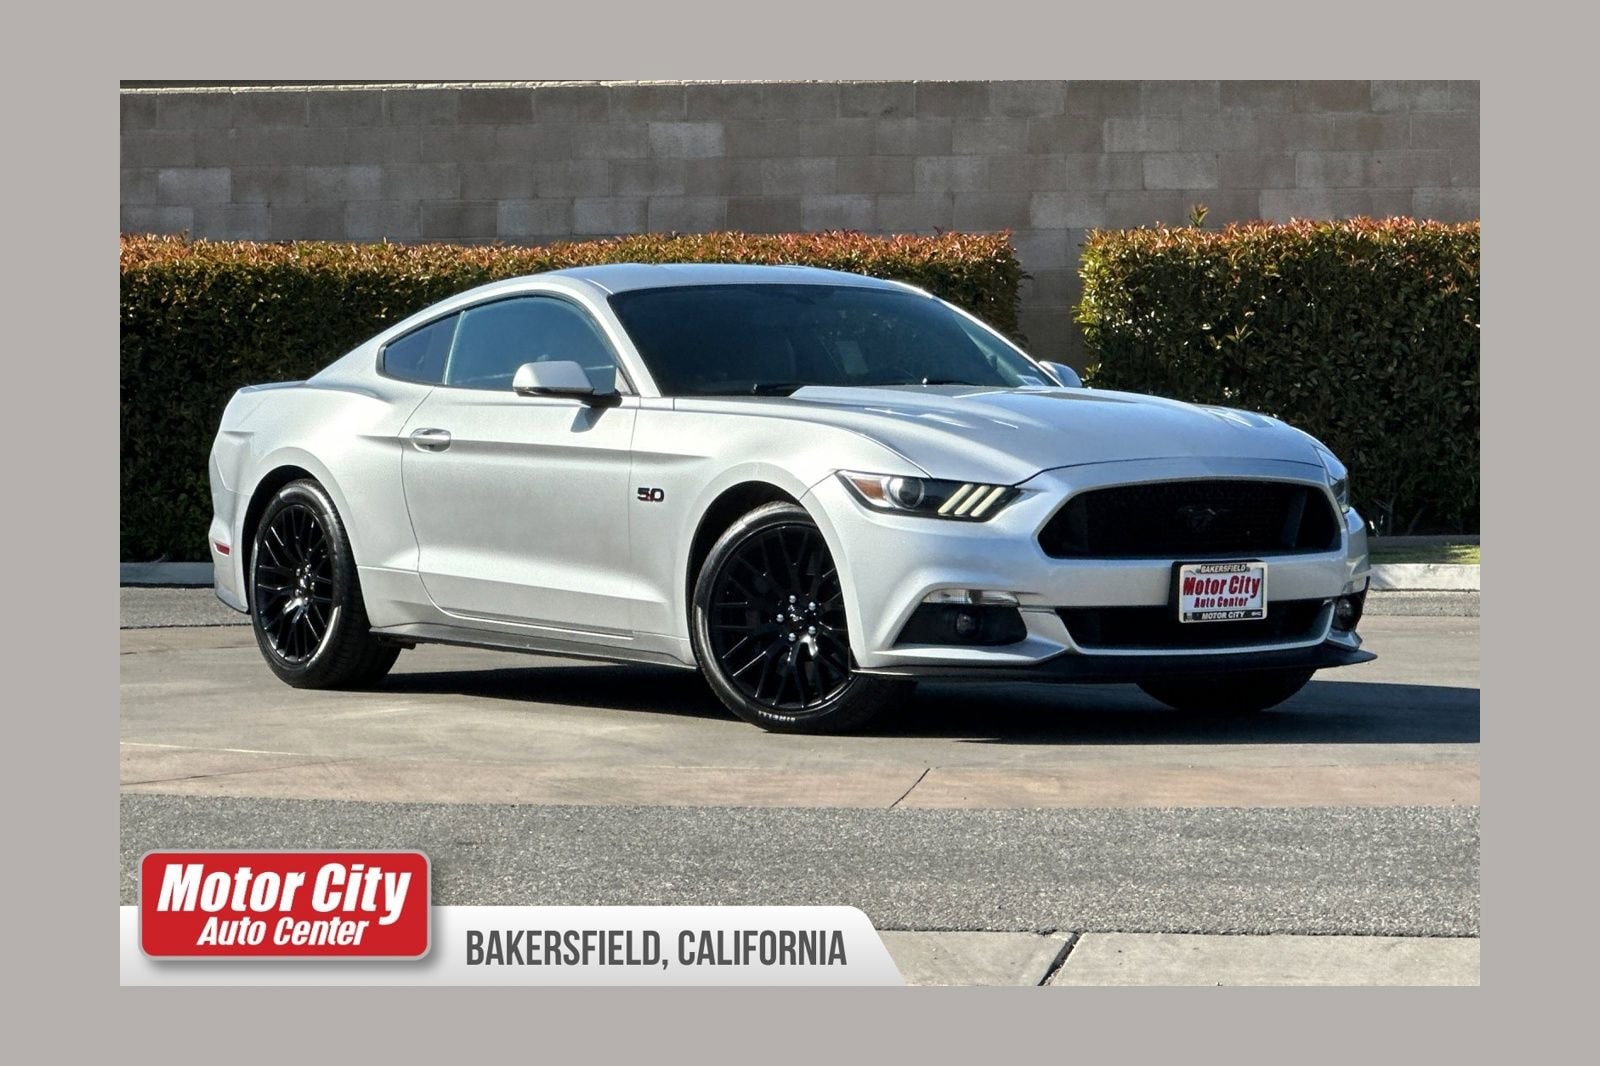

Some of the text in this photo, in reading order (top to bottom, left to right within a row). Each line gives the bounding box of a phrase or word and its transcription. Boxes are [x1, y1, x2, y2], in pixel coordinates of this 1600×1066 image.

[1201, 564, 1246, 573] BAKERSFIELD
[1183, 575, 1260, 598] Motor City
[1194, 597, 1248, 608] Auto Center
[1202, 612, 1227, 620] MOTOR
